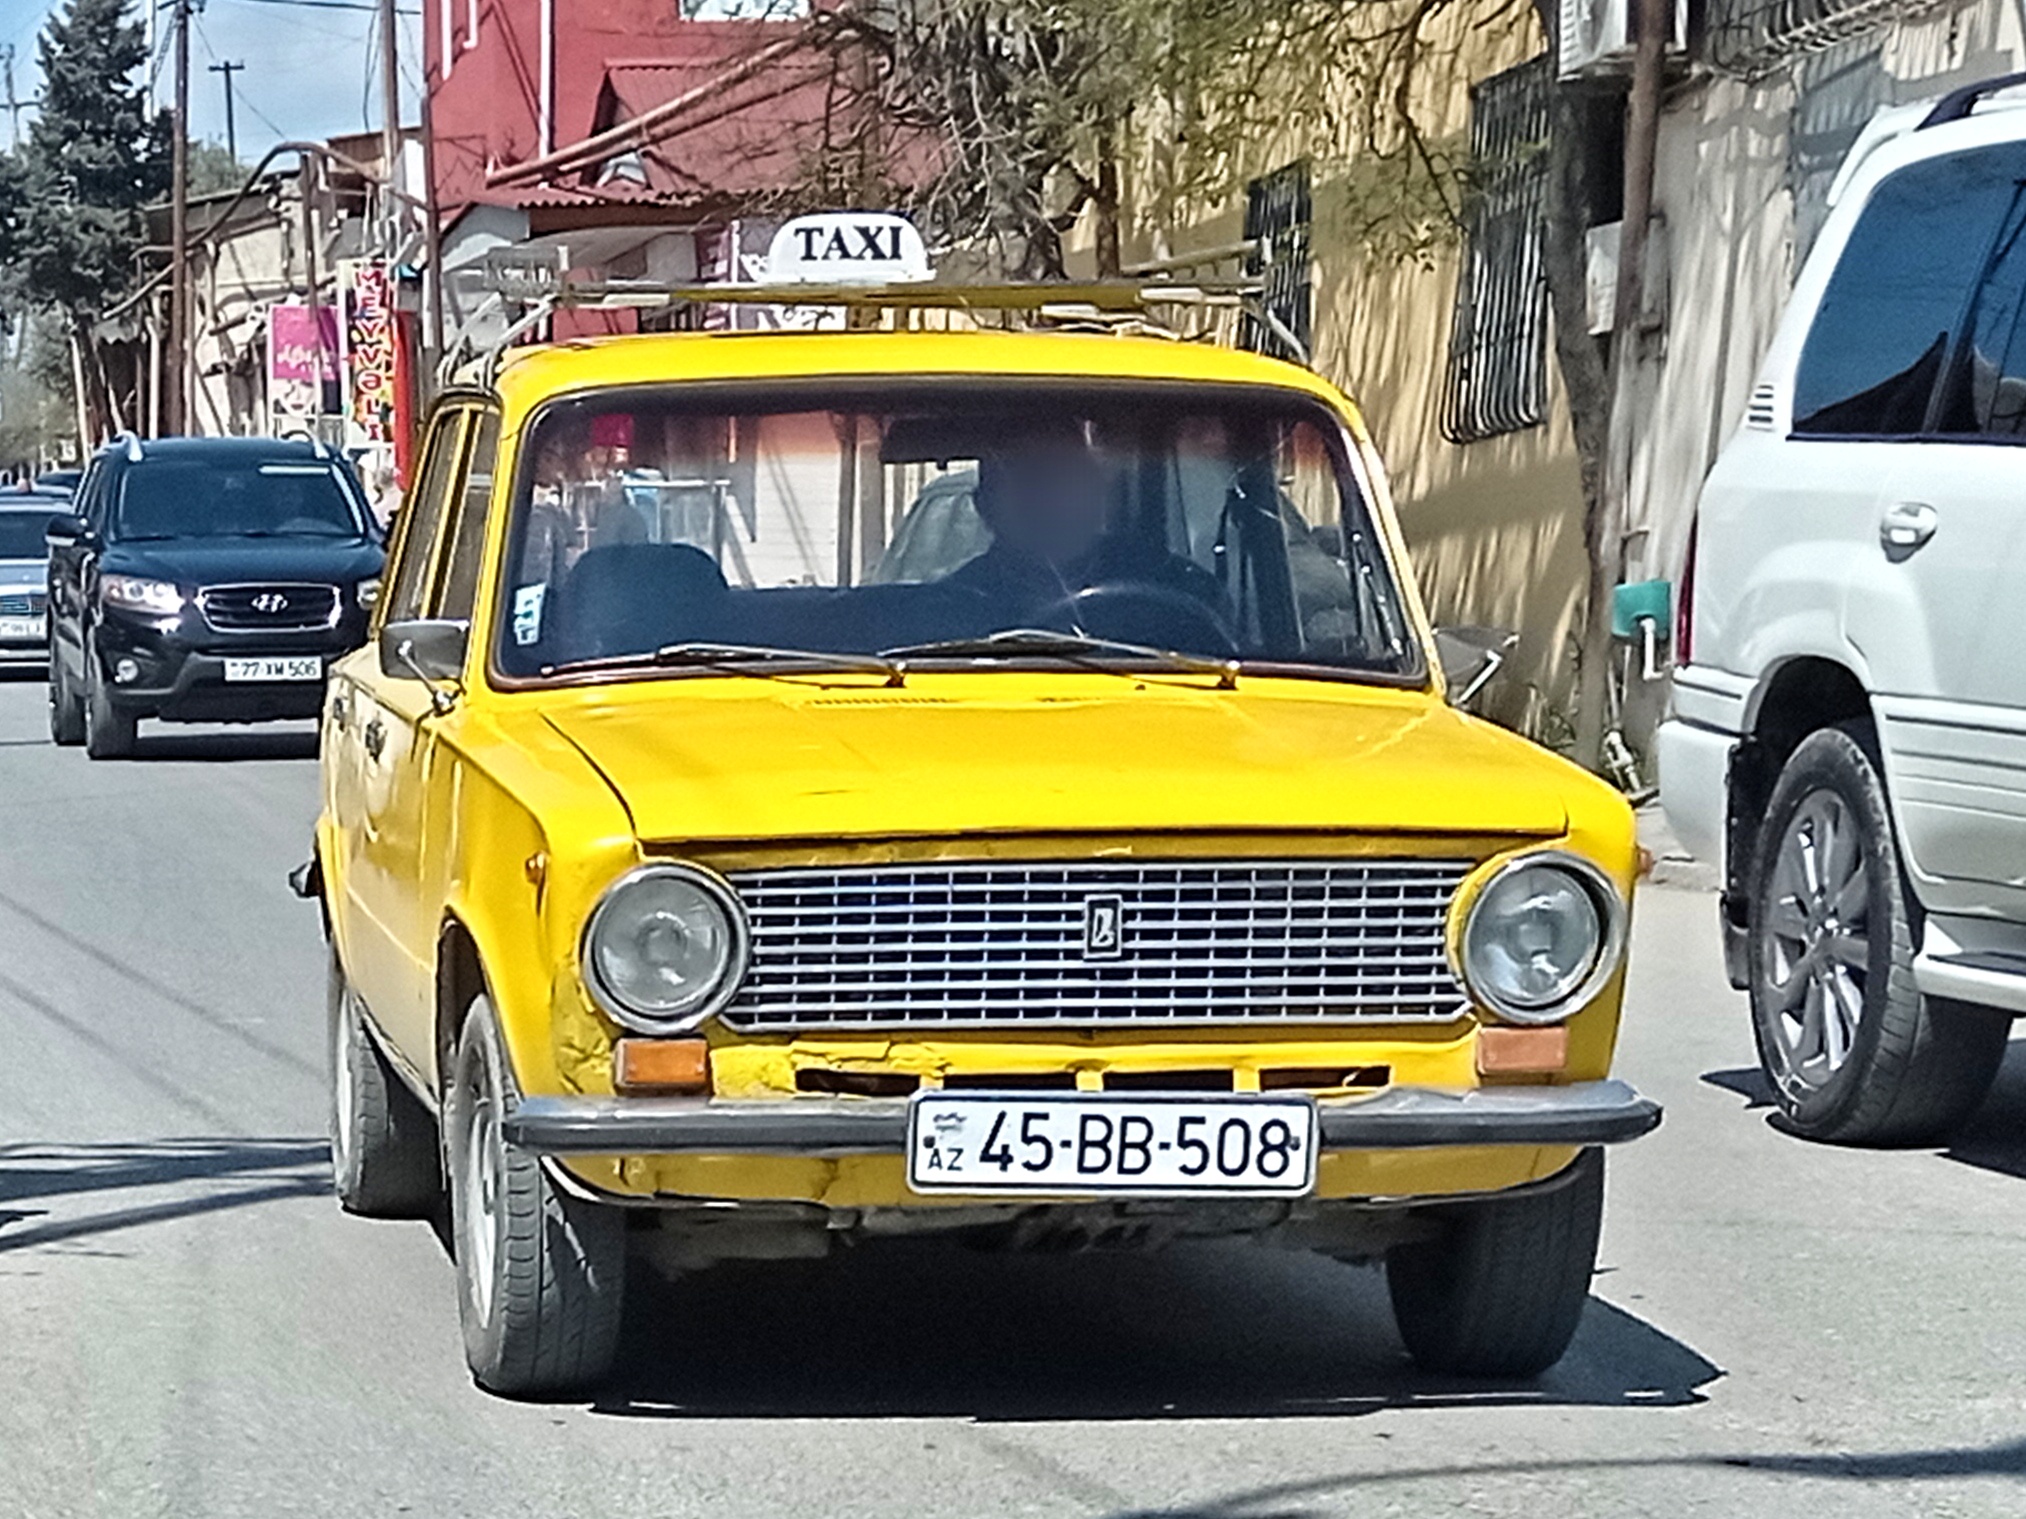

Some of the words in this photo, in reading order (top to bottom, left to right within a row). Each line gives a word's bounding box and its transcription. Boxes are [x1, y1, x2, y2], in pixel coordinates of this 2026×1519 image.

[793, 226, 903, 261] TAXI
[928, 1148, 963, 1171] AZ
[979, 1110, 1291, 1178] 45-BB-508
